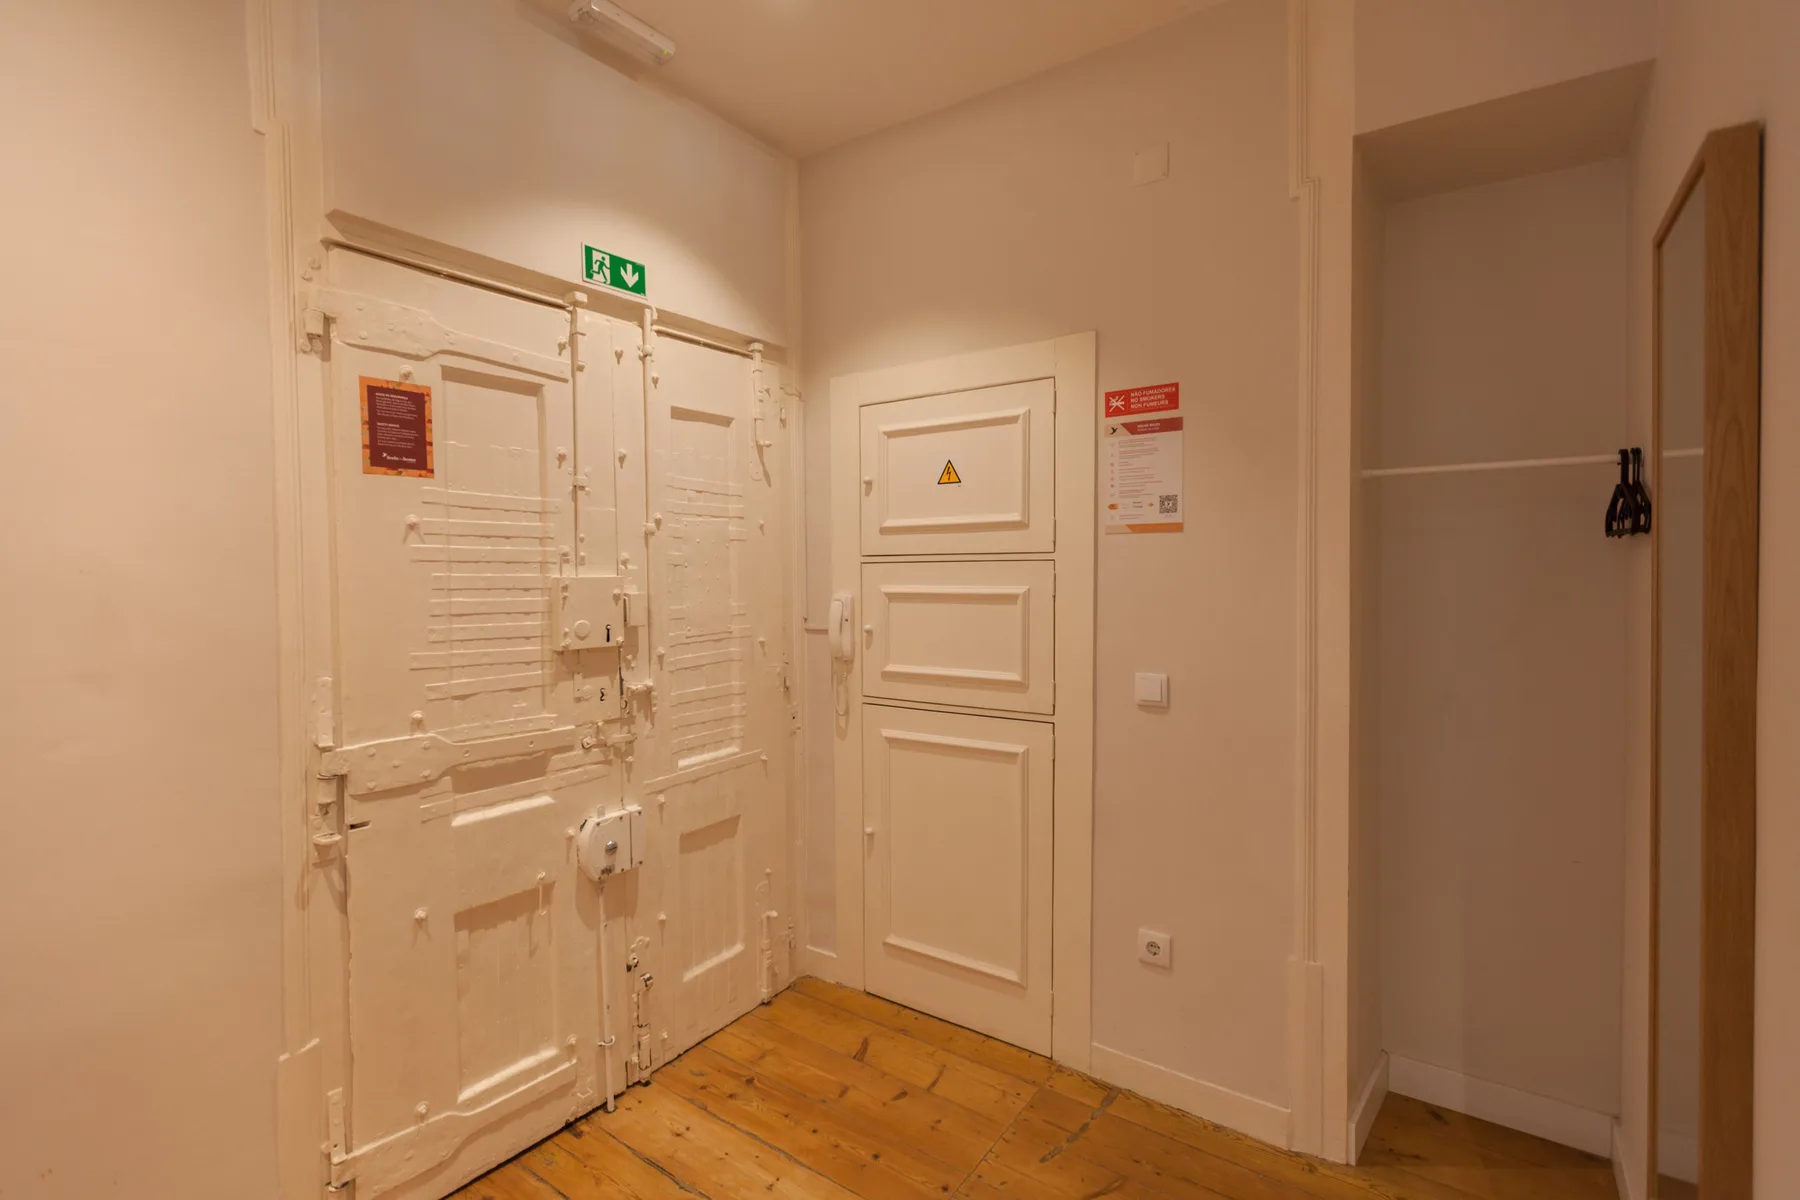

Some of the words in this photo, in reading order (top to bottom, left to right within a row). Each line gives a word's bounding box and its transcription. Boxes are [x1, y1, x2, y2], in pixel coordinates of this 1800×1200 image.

[1143, 386, 1176, 396] FUMADORES
[1139, 394, 1165, 402] SMOKERS
[1143, 400, 1169, 408] FUMEURS
